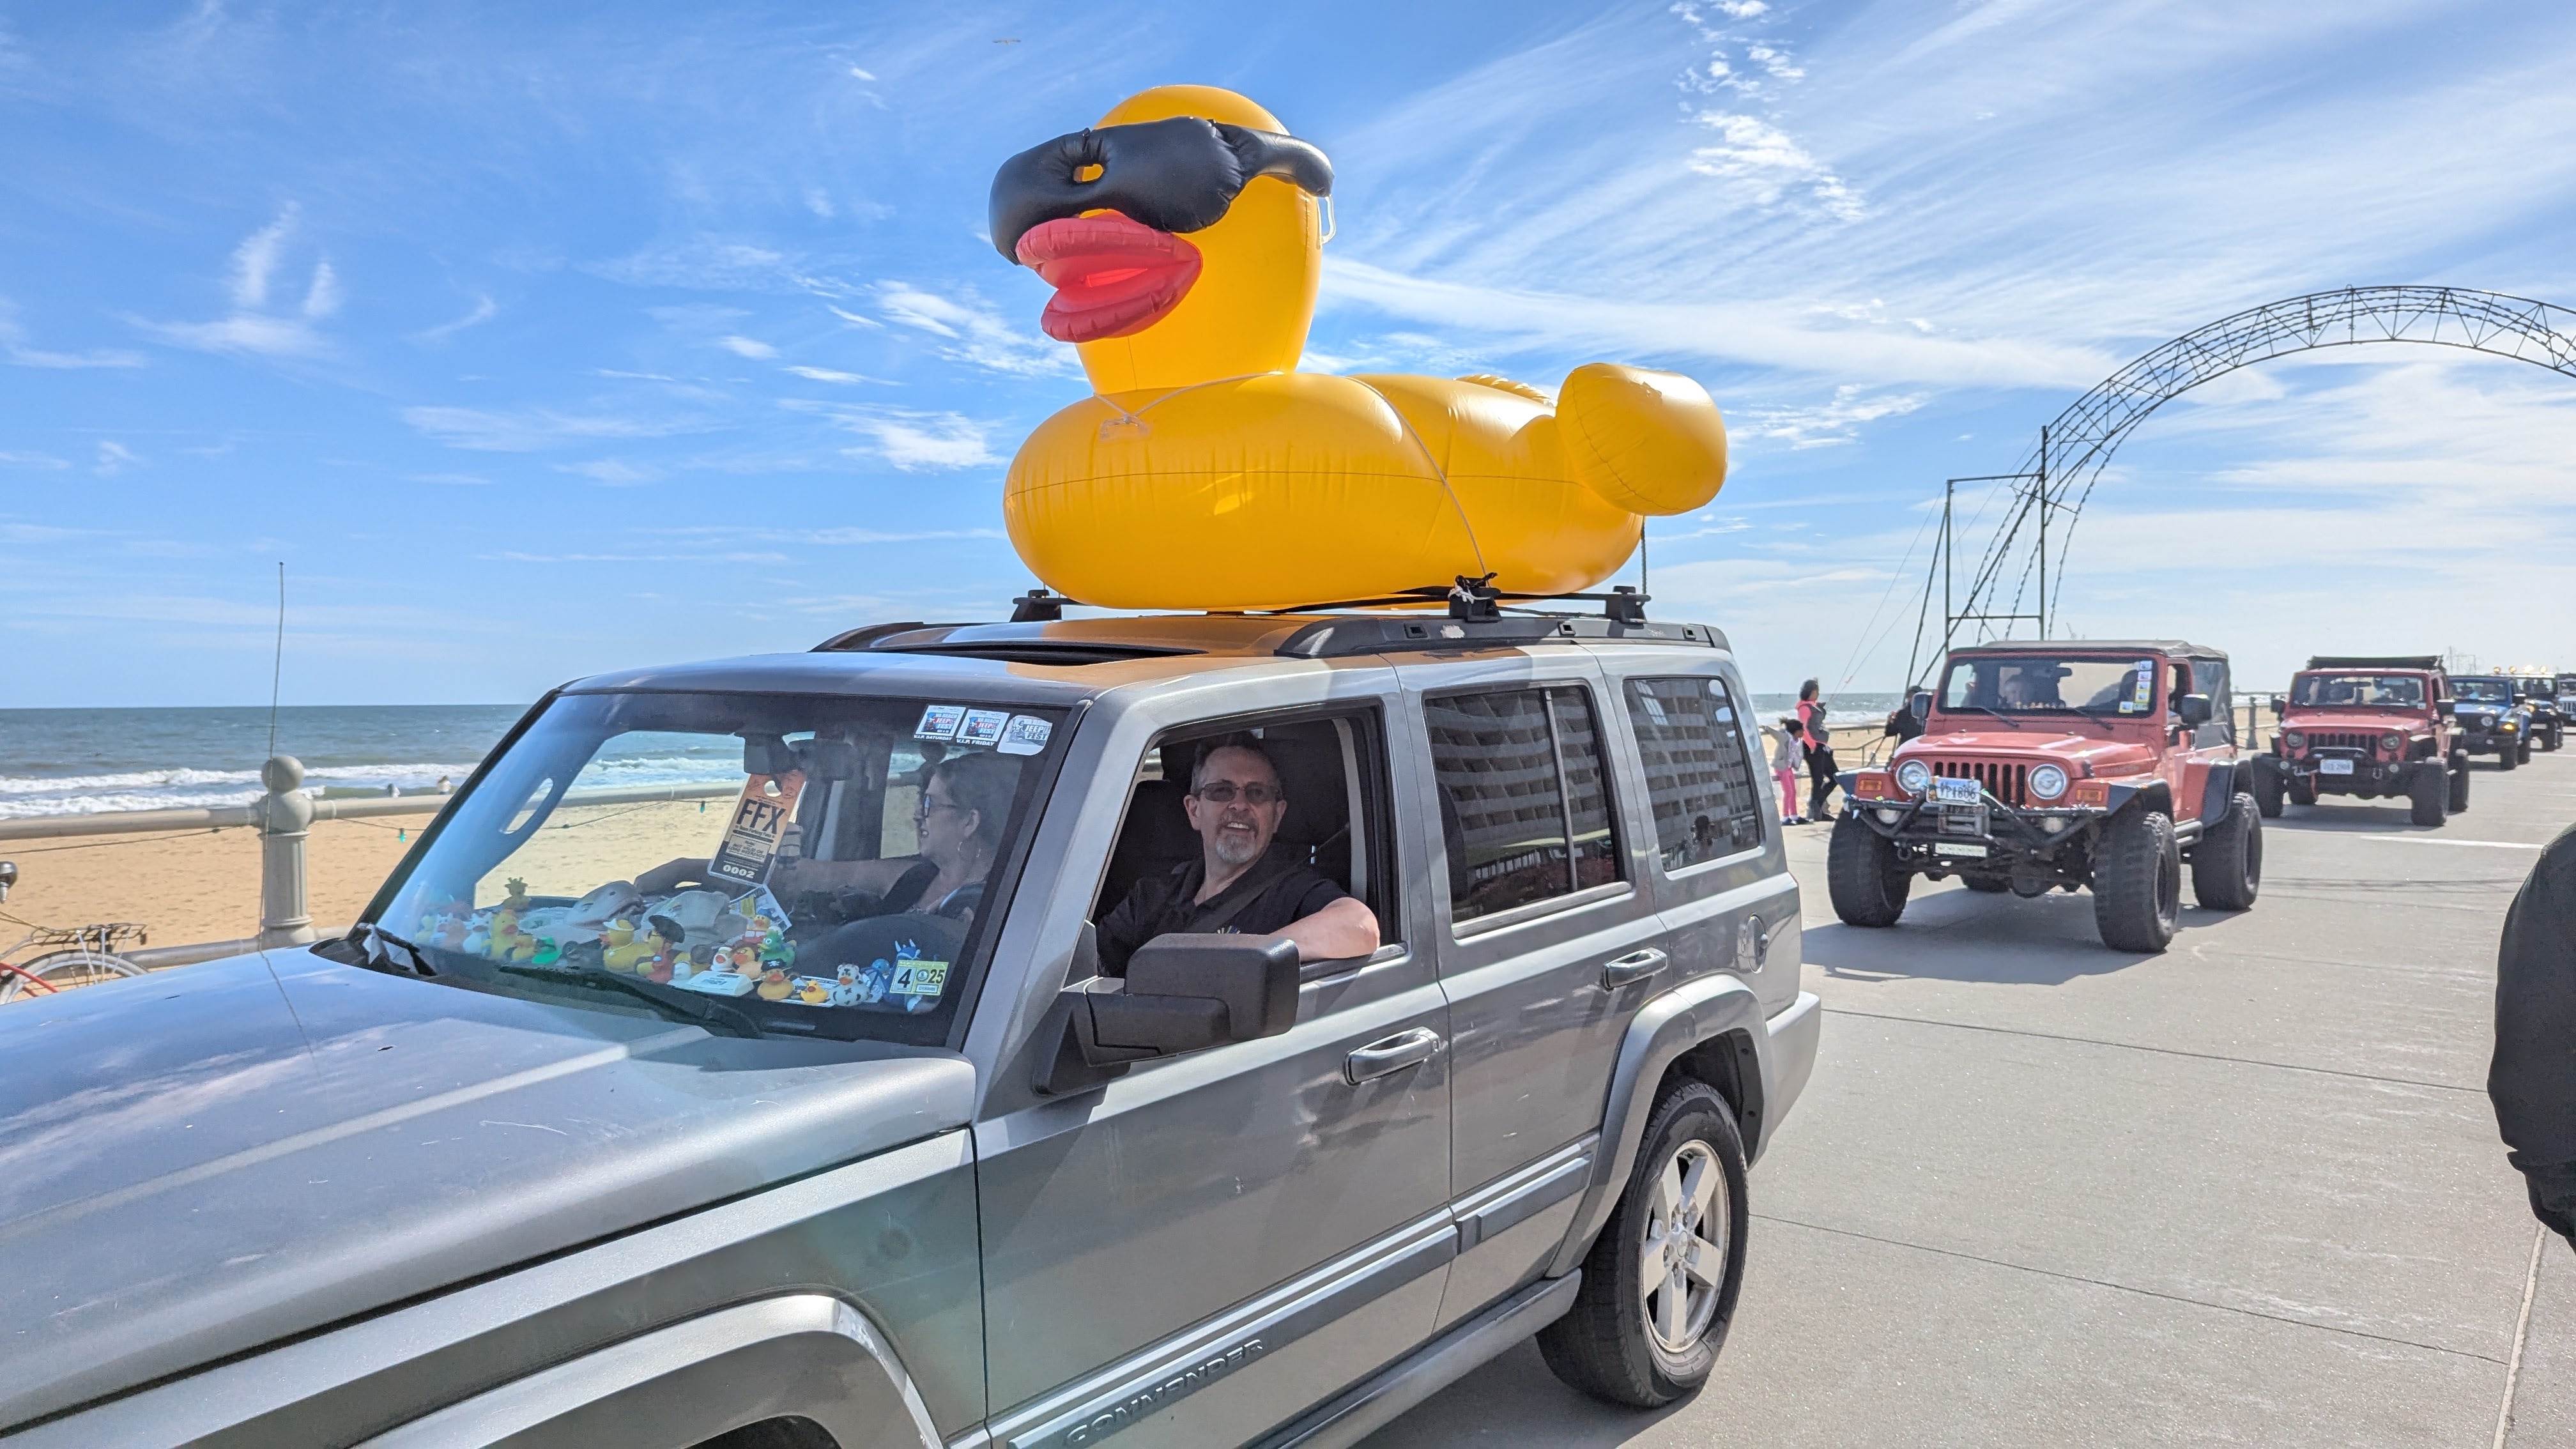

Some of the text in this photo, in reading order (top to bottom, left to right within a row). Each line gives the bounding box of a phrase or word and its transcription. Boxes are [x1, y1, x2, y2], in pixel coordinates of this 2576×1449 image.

[1024, 724, 1045, 733] JEEP
[736, 799, 786, 834] FFX
[723, 864, 755, 879] 0002
[898, 968, 945, 988] 4 25
[1063, 1339, 1263, 1444] COMMANDER
